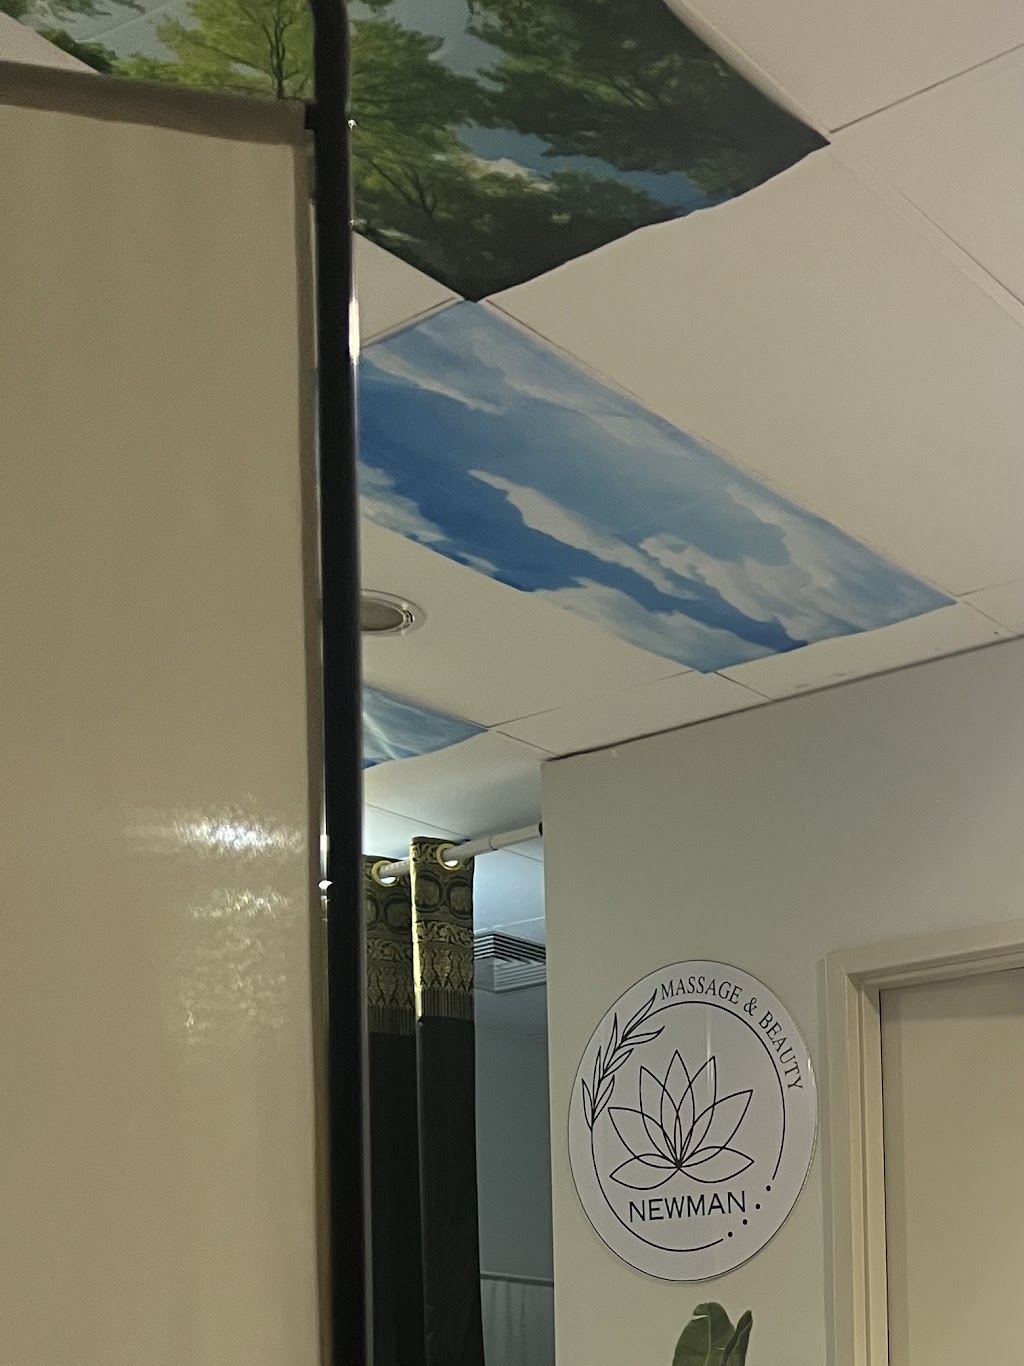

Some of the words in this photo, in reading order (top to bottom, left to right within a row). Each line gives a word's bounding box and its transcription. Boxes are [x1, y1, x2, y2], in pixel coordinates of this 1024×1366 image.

[661, 976, 743, 1005] MASSAGE
[743, 997, 759, 1017] &
[758, 1010, 804, 1091] BEAUTY
[629, 1190, 746, 1223] NEWMAN
